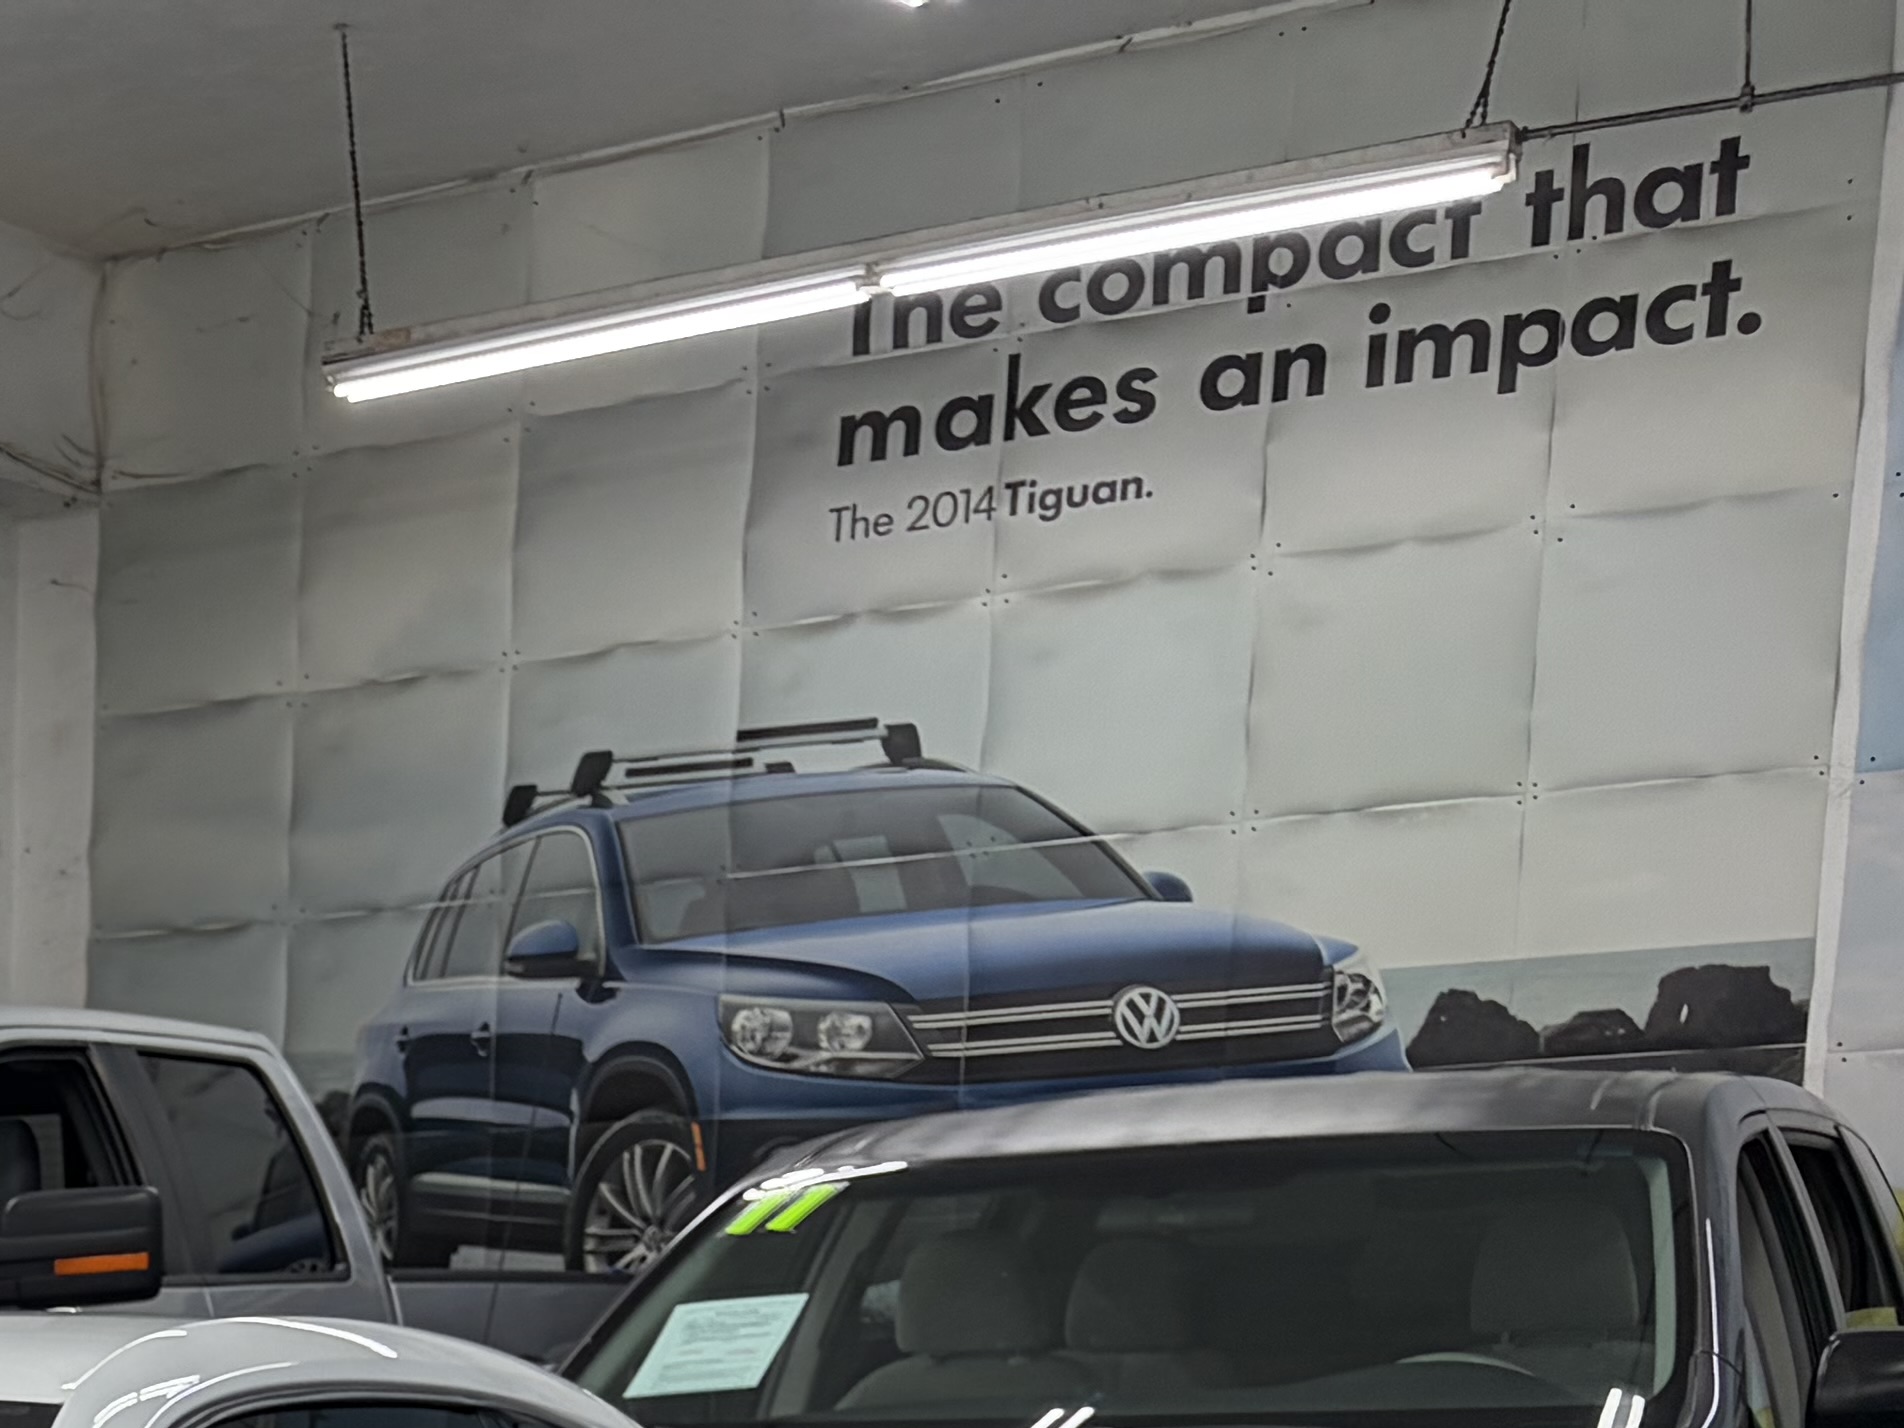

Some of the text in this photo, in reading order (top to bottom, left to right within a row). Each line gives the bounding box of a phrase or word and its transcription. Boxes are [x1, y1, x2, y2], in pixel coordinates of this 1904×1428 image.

[1038, 200, 1482, 314] compact
[1525, 136, 1751, 247] that
[837, 259, 1763, 467] makes an impact.
[829, 475, 1154, 542] The 2014 Tiguan.
